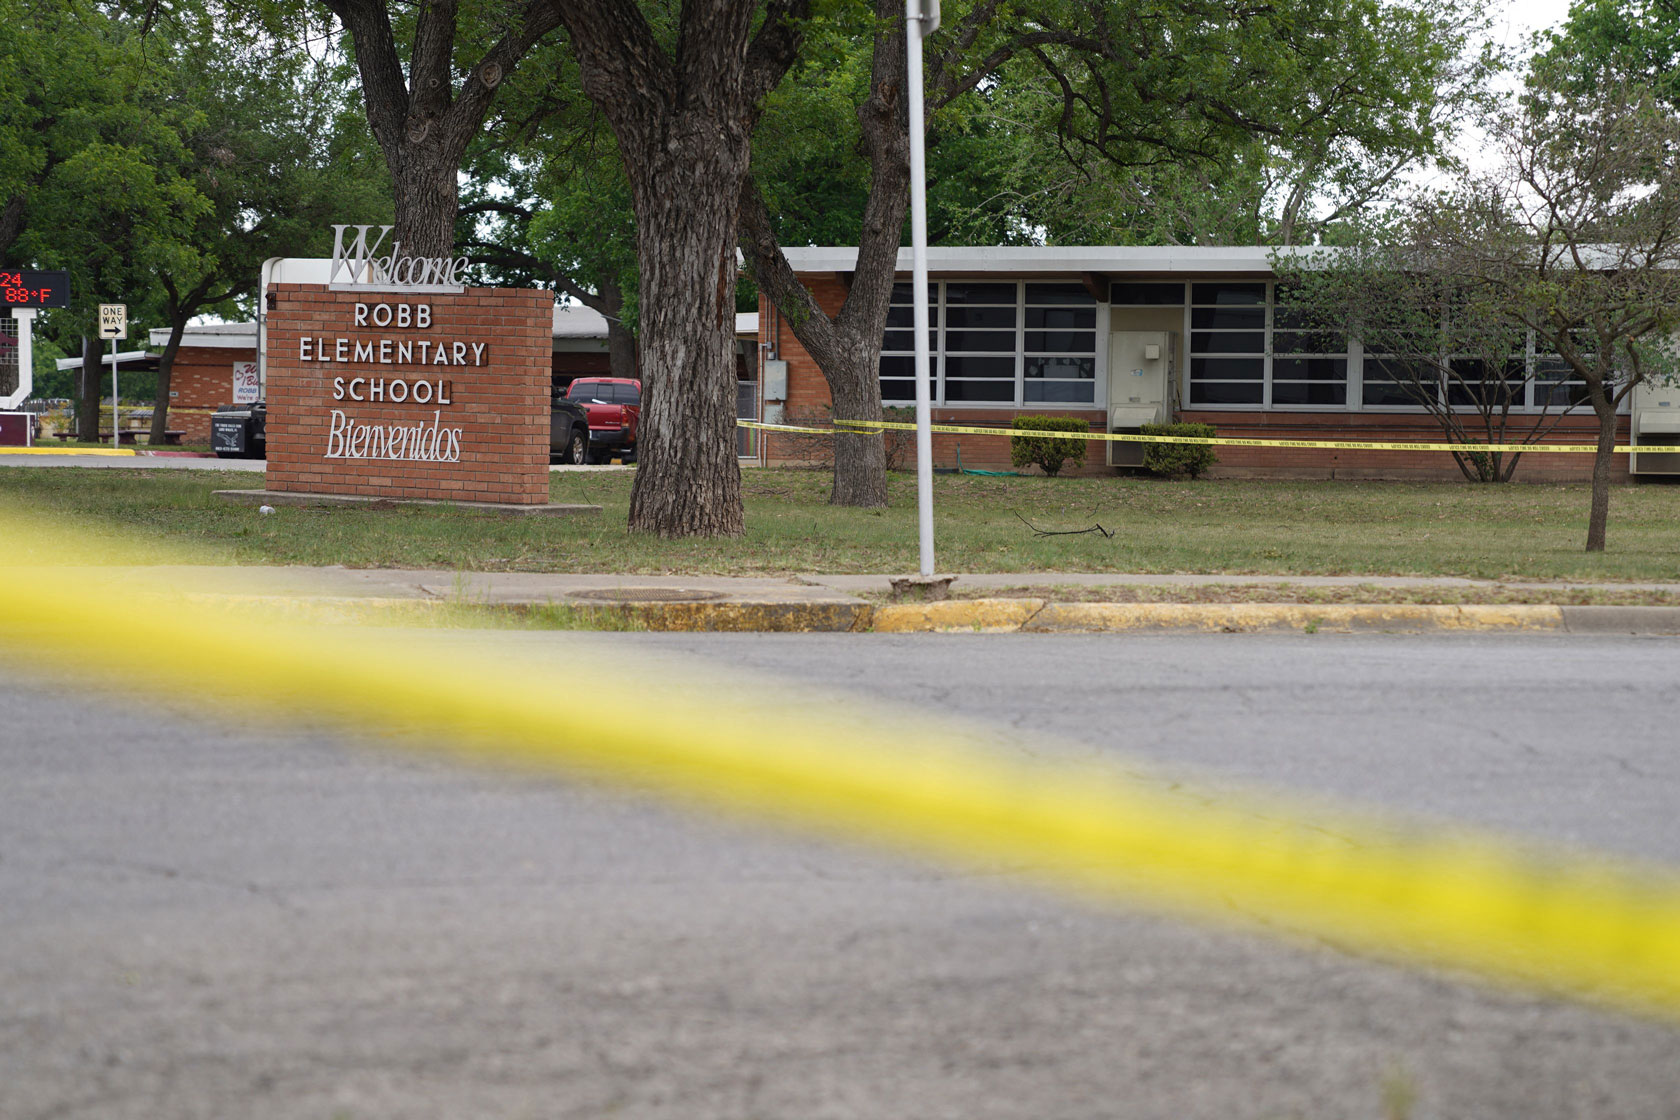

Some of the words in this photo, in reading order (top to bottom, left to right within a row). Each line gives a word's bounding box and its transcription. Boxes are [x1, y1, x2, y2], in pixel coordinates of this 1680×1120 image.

[331, 224, 469, 285] Welcome
[102, 316, 123, 325] WAY
[103, 307, 122, 316] ONE
[354, 303, 431, 328] ROBB
[300, 337, 485, 366] ELEMENTARY
[333, 377, 451, 405] SCHOOL
[325, 409, 463, 462] Bienvenidos
